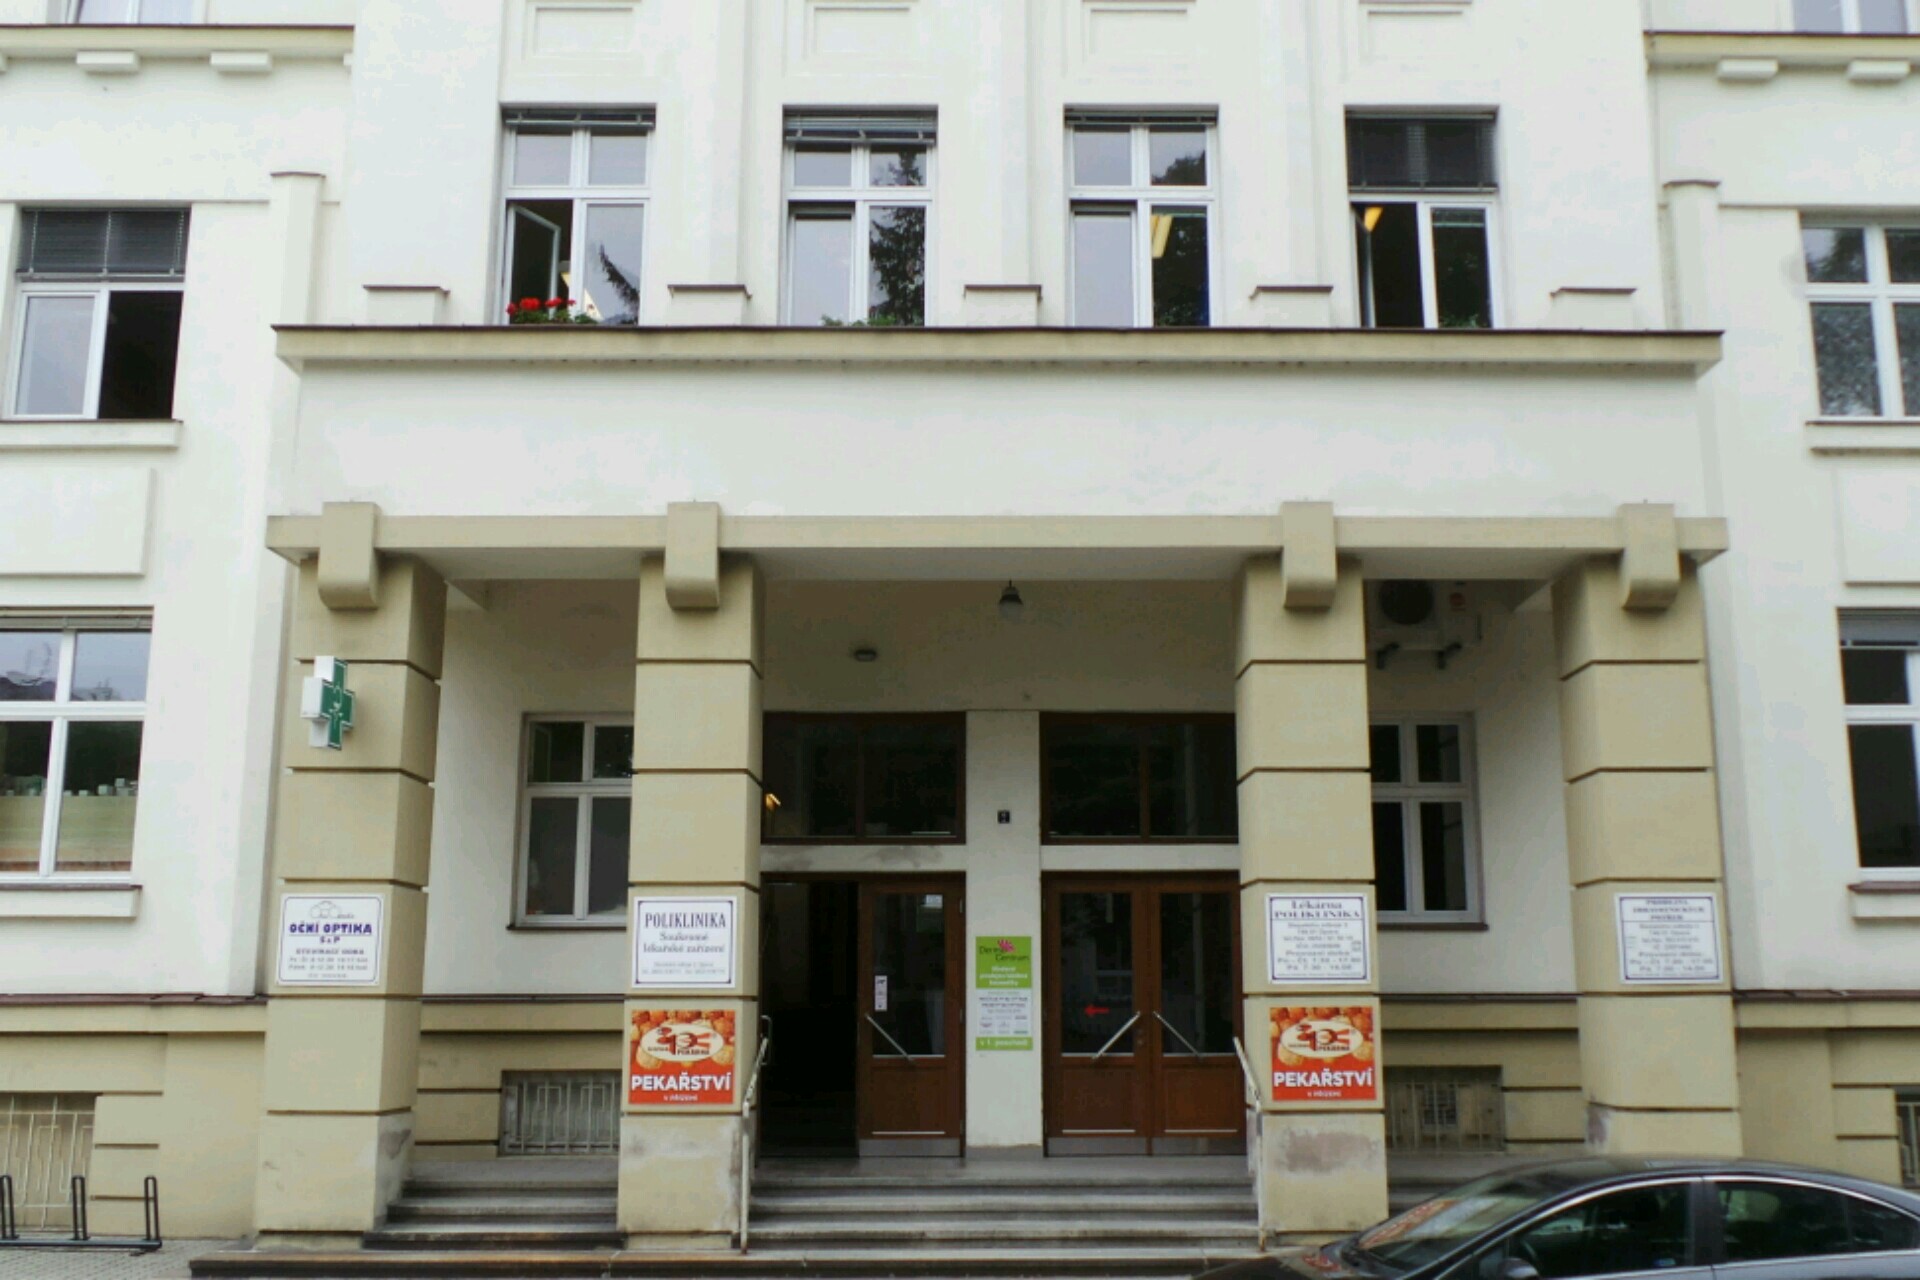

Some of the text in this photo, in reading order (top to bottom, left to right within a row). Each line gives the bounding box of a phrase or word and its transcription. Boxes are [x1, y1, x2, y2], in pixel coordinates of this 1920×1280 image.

[289, 920, 372, 933] OČNÍ OPTIKA
[645, 912, 726, 928] POLIKLINIKA
[631, 1071, 732, 1091] PEKAŘSTVÍ
[1273, 1067, 1373, 1087] PEKAŘSTVÍ
